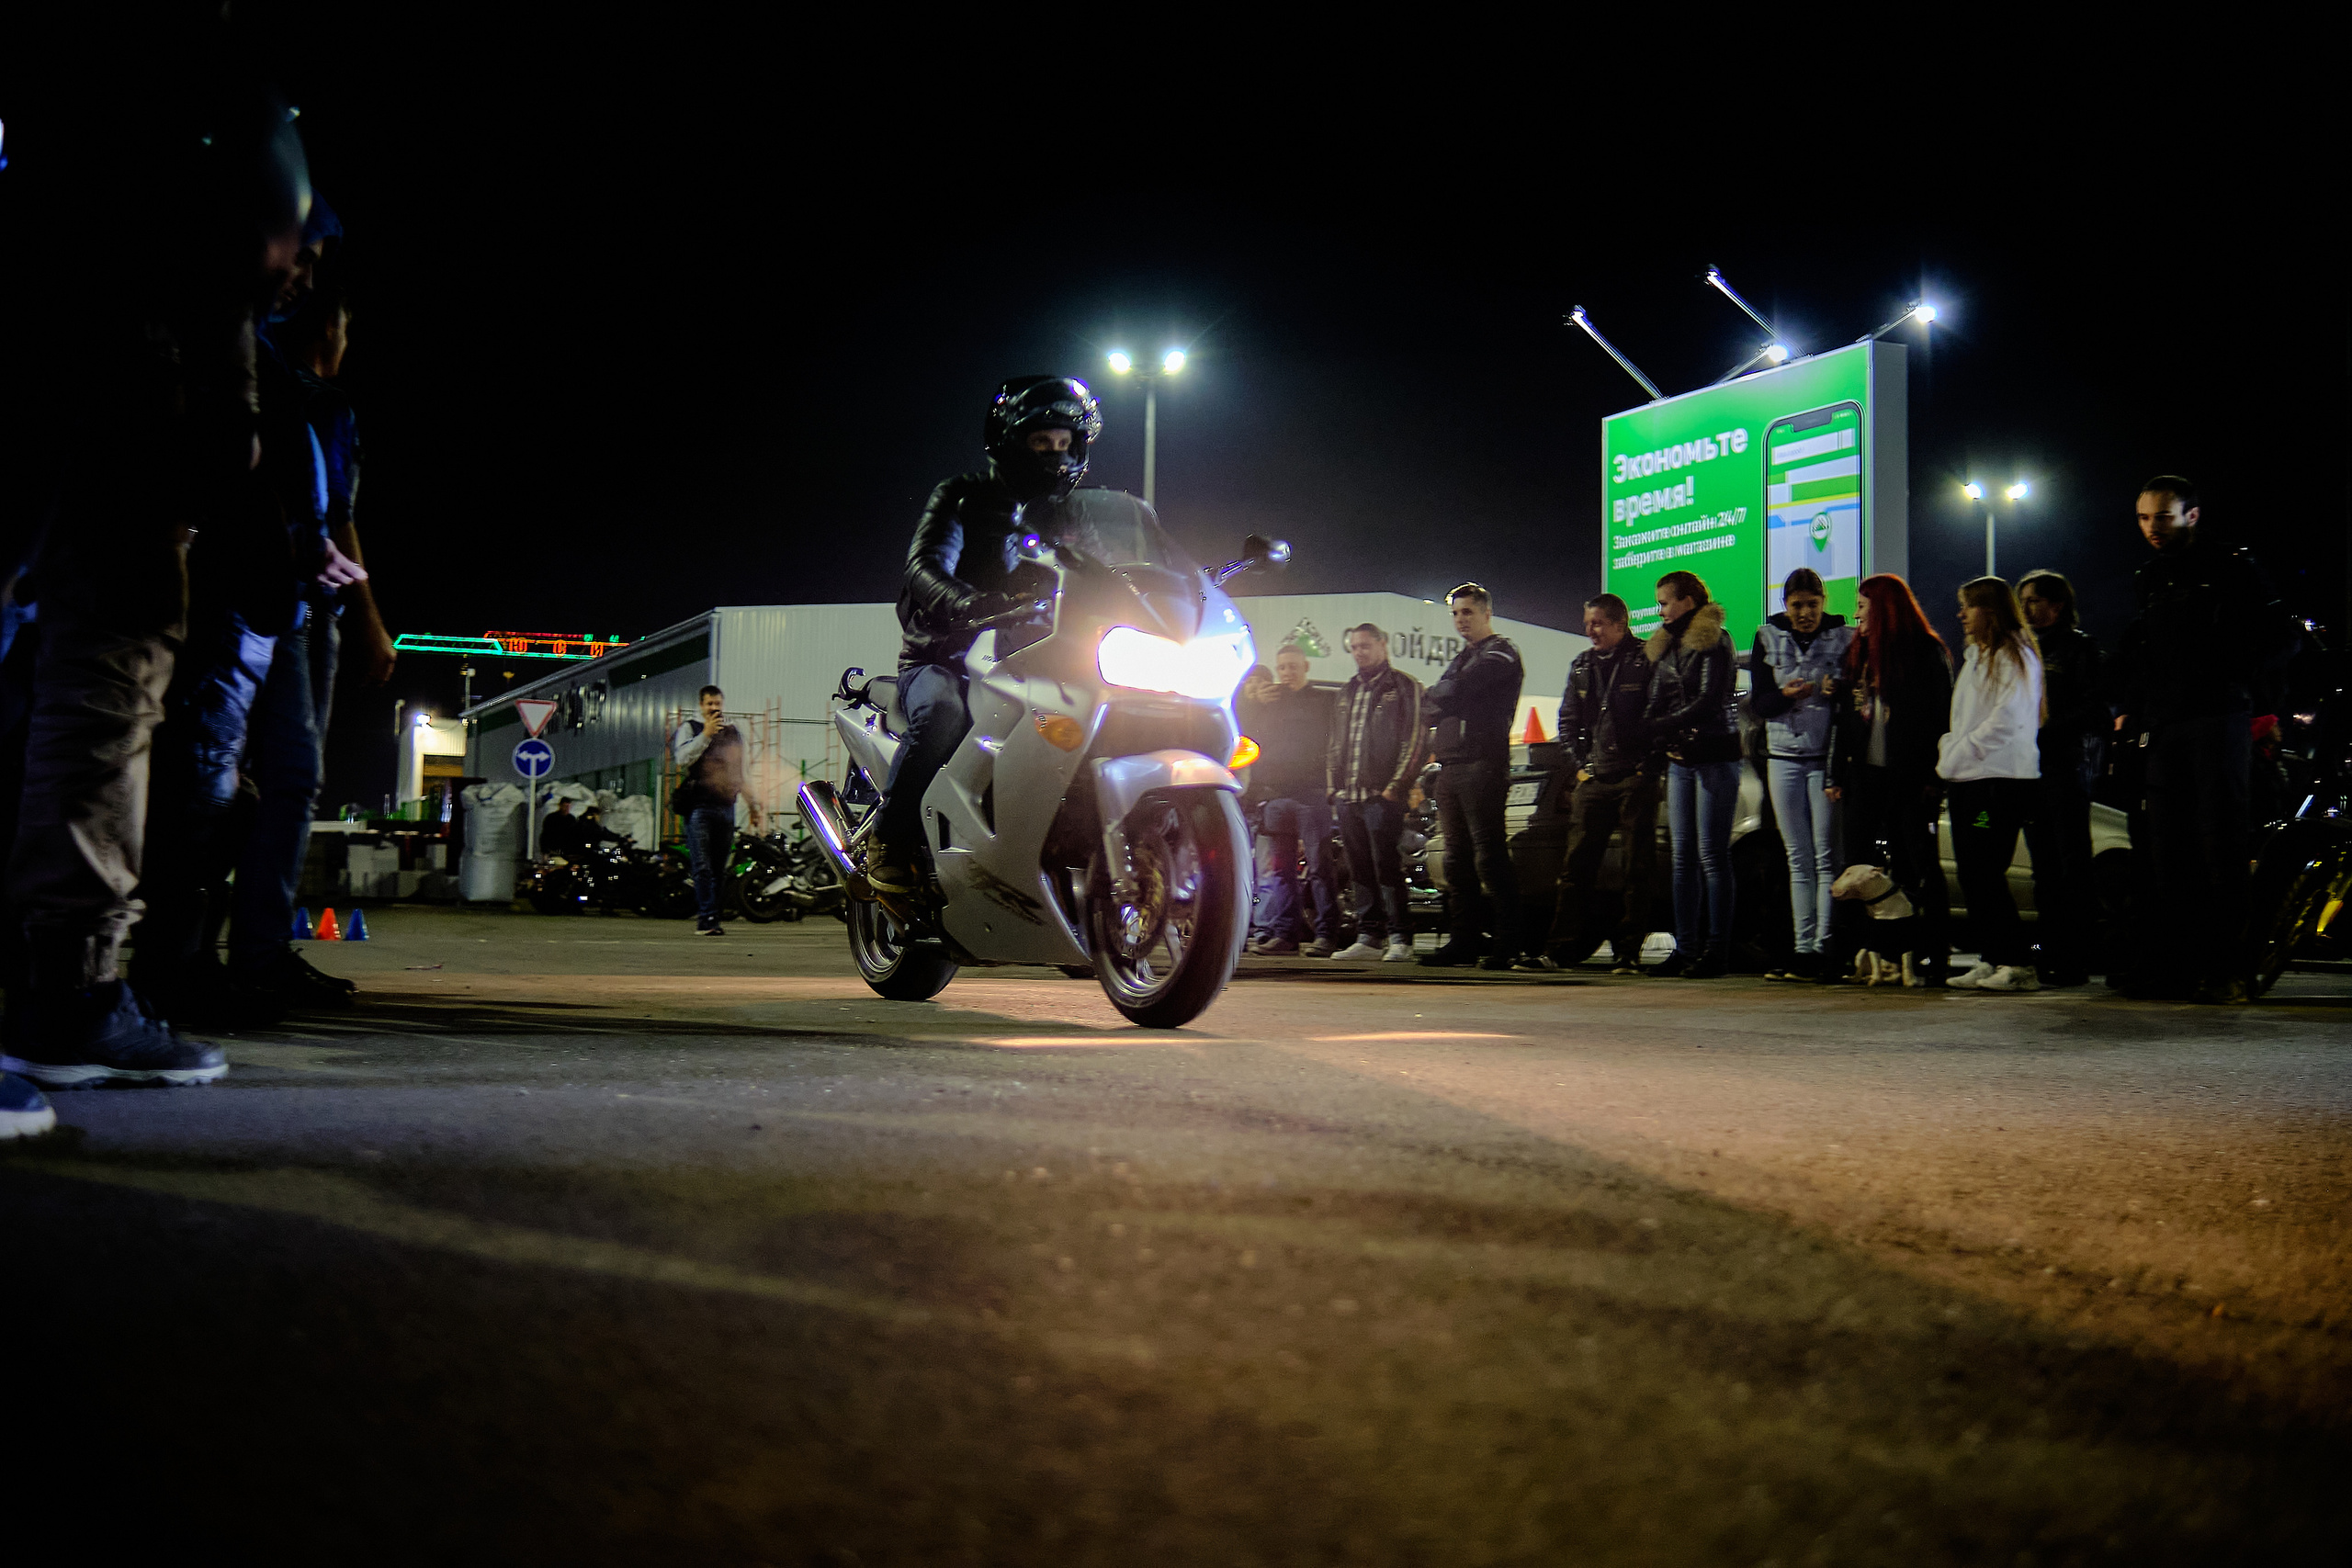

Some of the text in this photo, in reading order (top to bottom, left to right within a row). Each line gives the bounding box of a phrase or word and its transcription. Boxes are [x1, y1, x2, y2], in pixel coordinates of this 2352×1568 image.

[1612, 428, 1748, 483] Экономьте
[1612, 476, 1694, 527] время!
[1612, 526, 1669, 550] Закажите
[1717, 507, 1747, 532] 24/7
